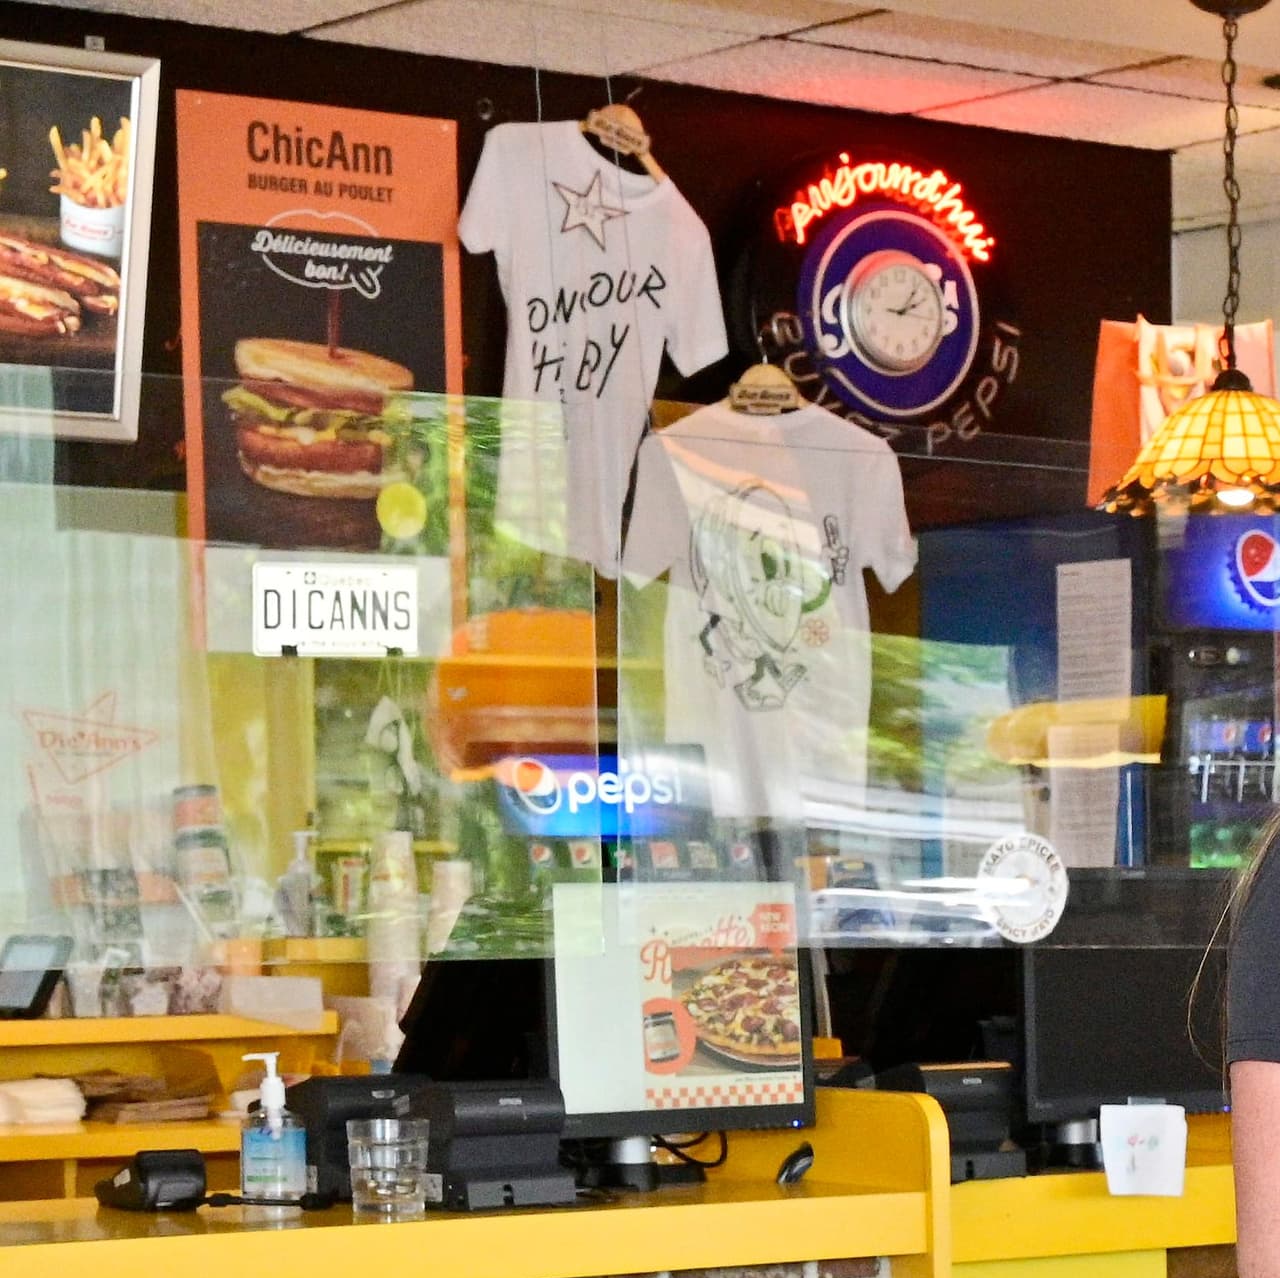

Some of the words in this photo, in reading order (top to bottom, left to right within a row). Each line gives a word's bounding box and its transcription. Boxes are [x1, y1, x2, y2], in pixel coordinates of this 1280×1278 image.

[247, 120, 393, 176] ChicAnn
[247, 173, 308, 195] BURGER
[313, 180, 333, 197] AU
[339, 183, 394, 204] POULET
[251, 229, 394, 264] Délicieusement
[926, 320, 1022, 456] PEPSI
[263, 588, 411, 631] DICANNS
[567, 766, 683, 815] pepsi
